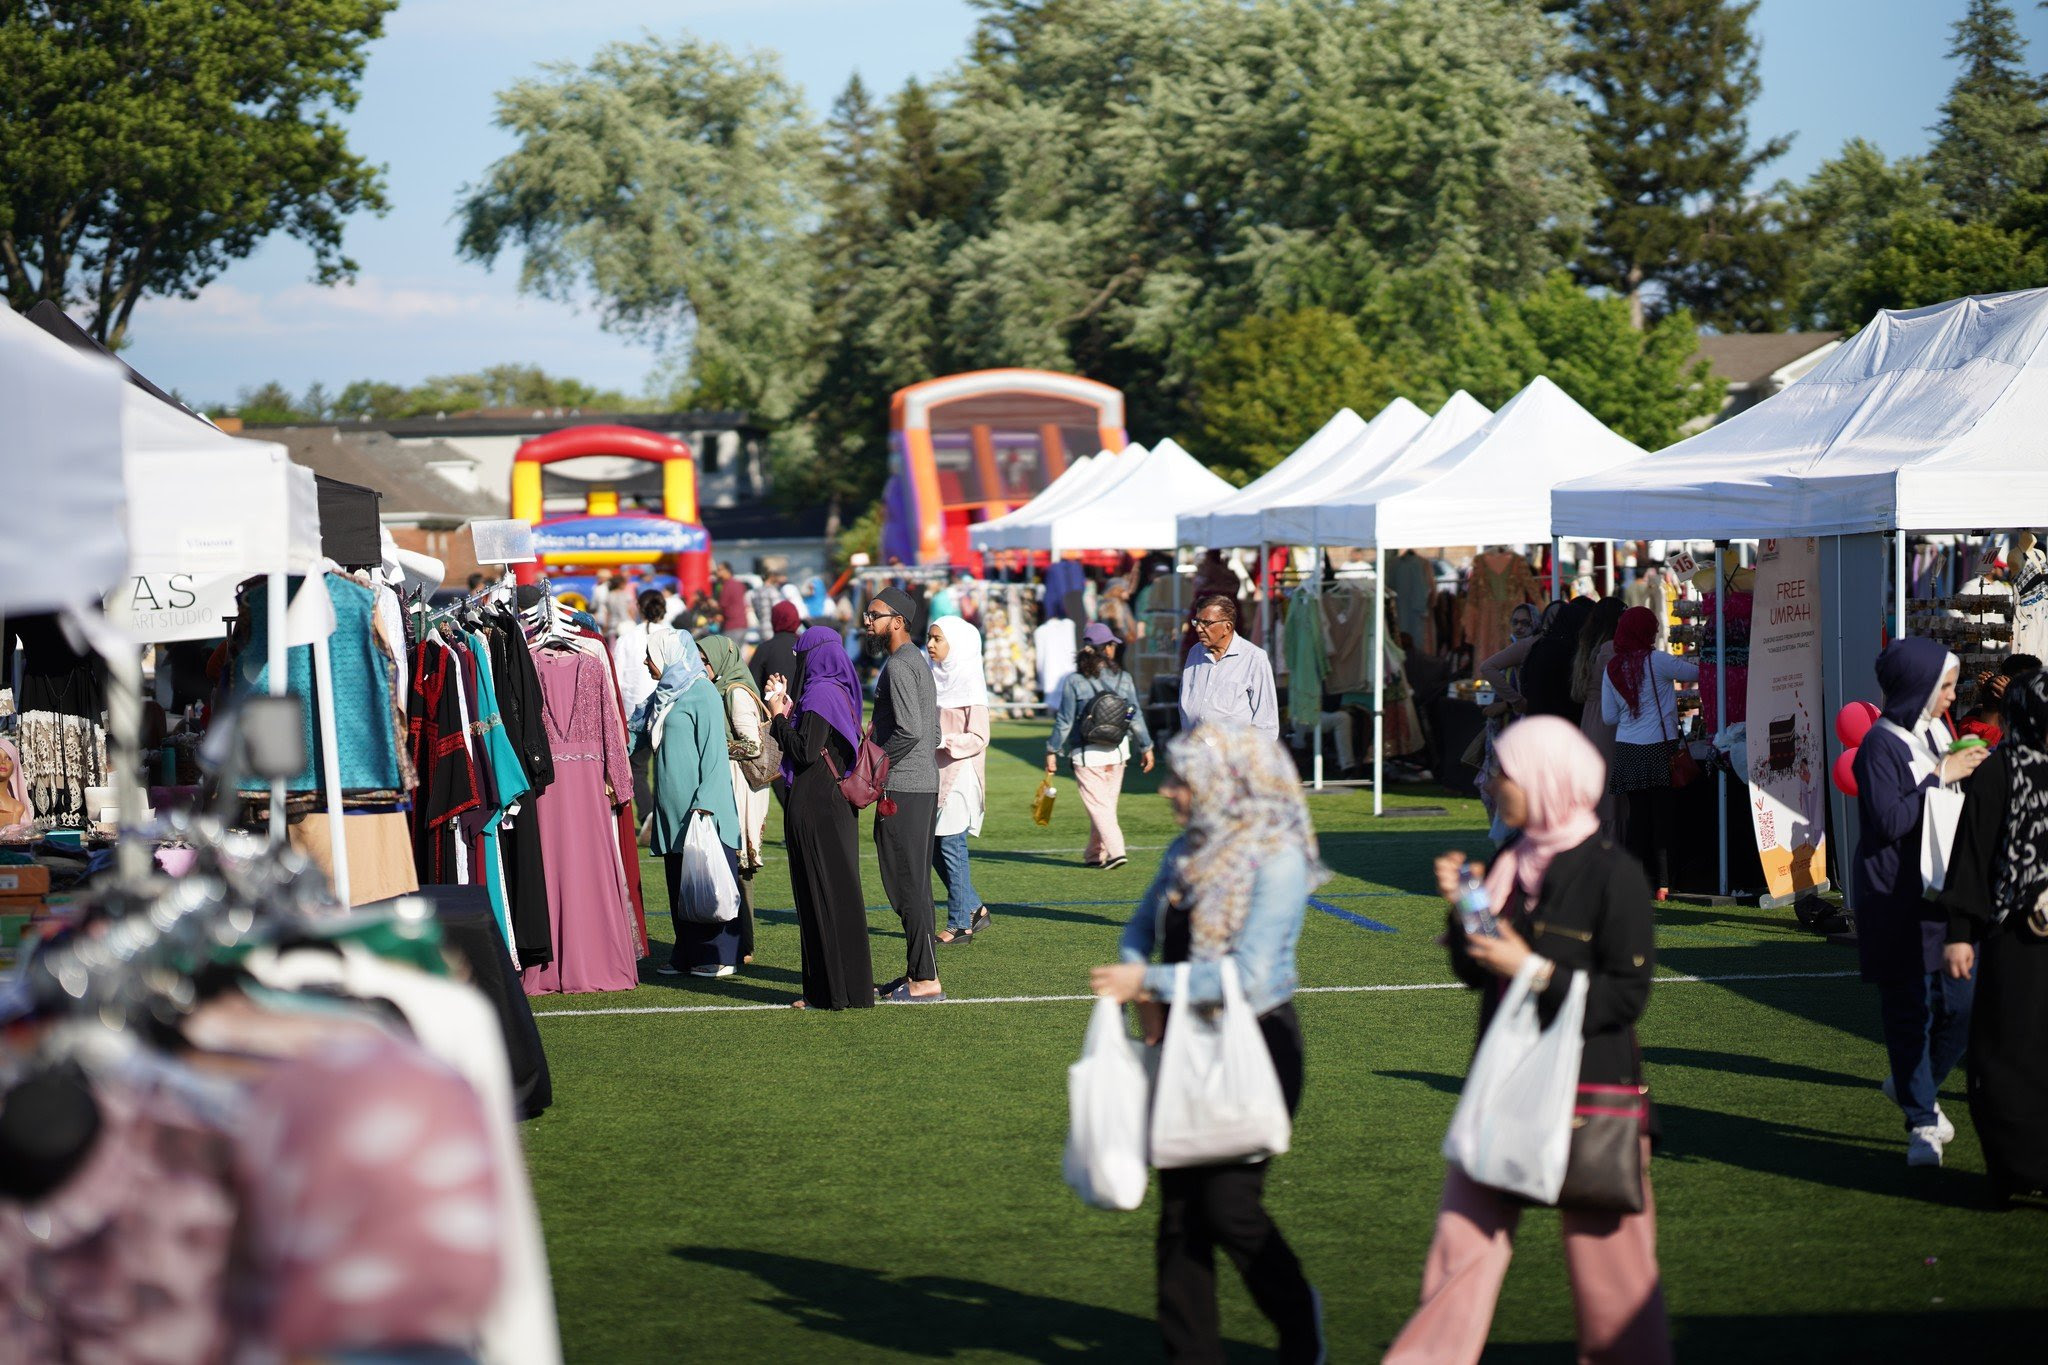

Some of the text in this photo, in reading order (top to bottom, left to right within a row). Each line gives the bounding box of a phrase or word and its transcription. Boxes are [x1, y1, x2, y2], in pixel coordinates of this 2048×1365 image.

[1672, 555, 1694, 573] $15
[1777, 580, 1805, 600] FREE
[132, 607, 213, 629] ART STUDIO
[1770, 603, 1810, 625] UMRAH
